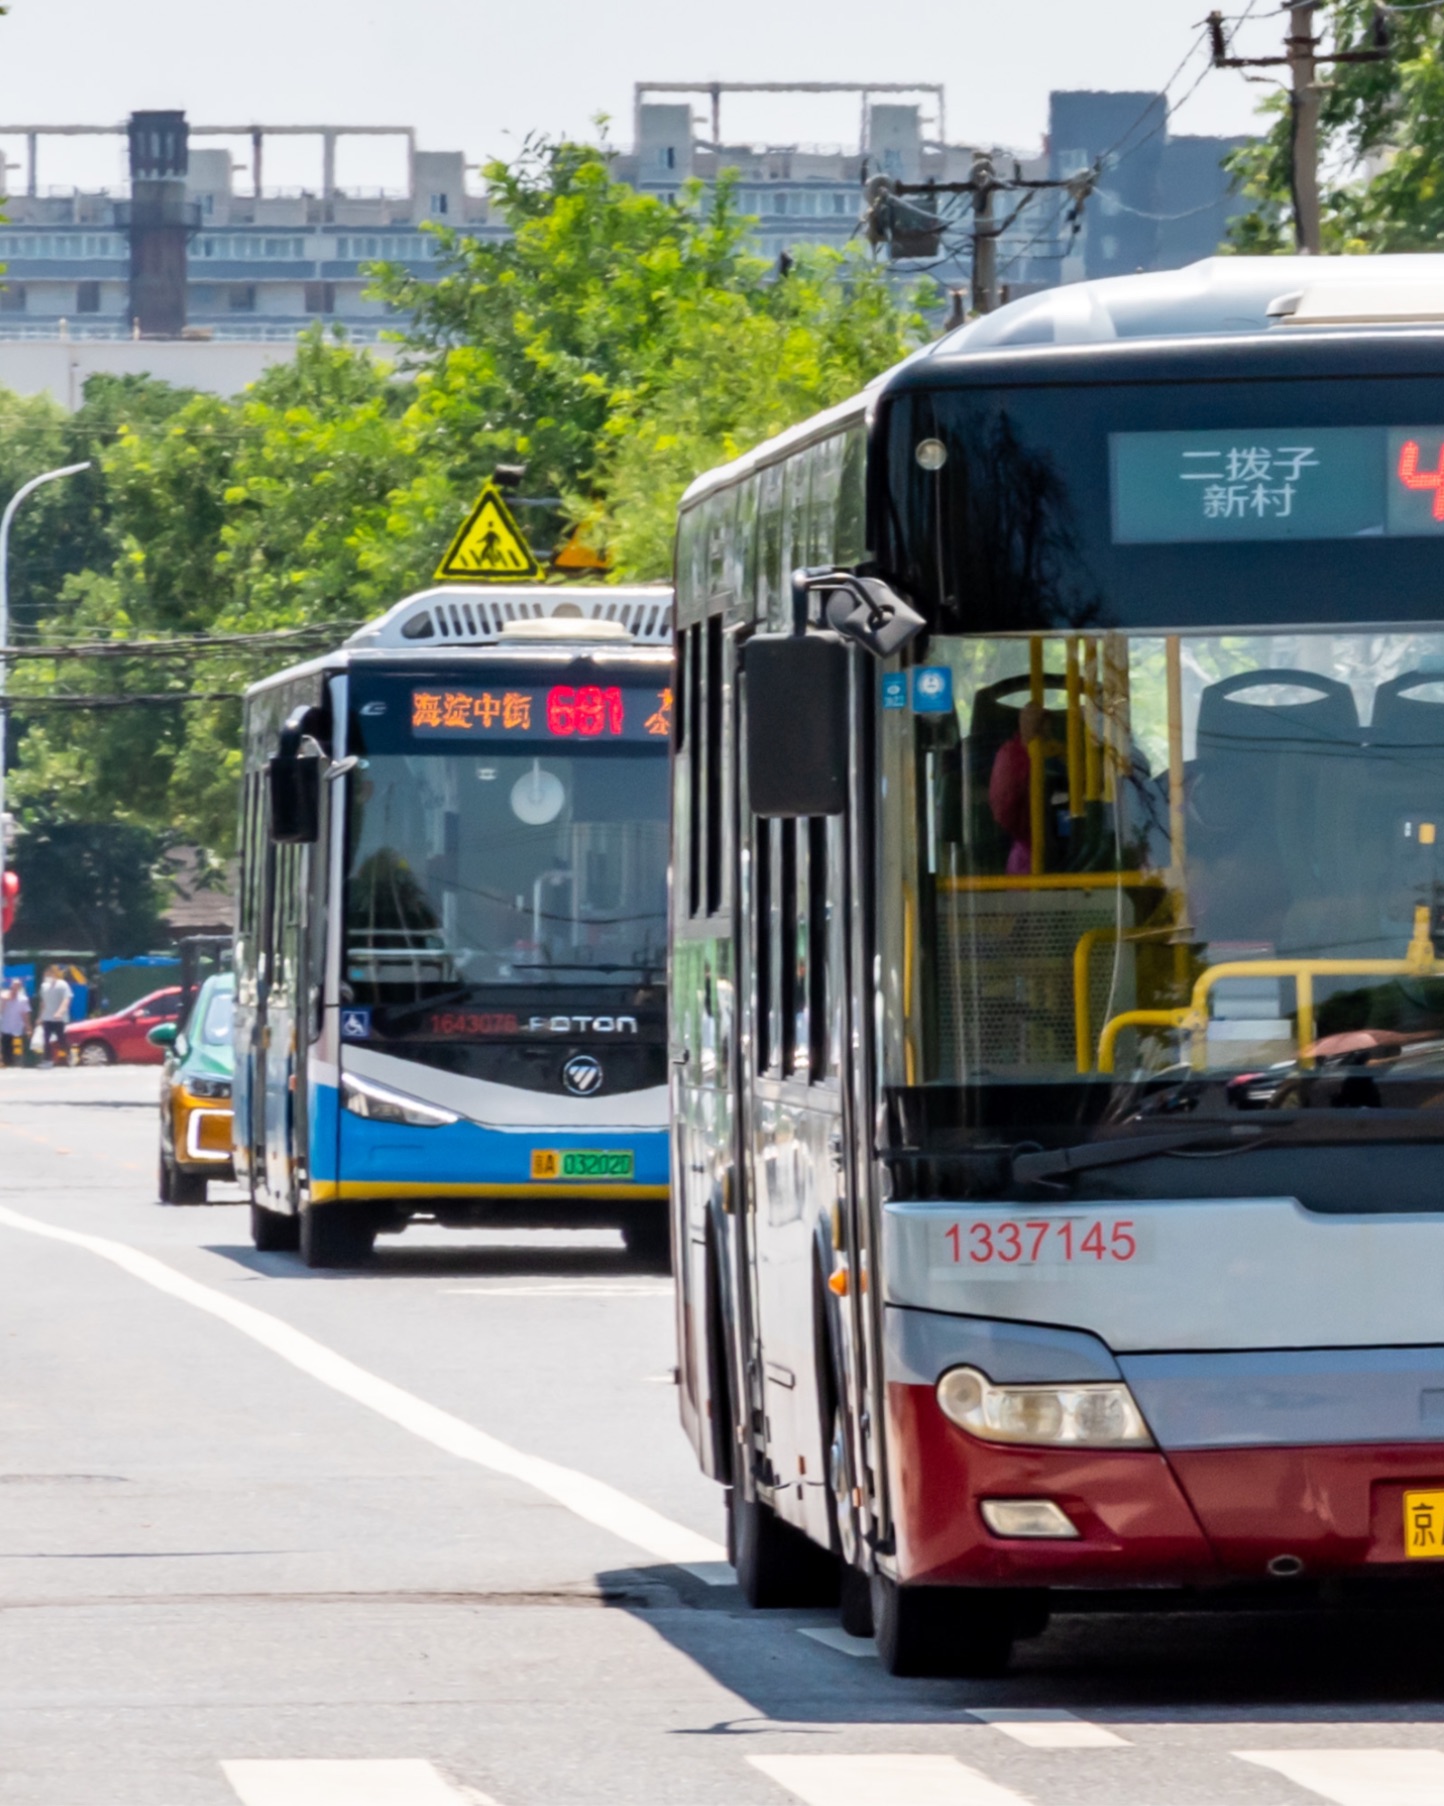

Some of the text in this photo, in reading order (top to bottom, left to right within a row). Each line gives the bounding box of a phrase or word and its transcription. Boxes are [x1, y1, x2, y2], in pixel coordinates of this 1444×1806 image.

[1179, 447, 1320, 482] 二拨子
[1203, 483, 1297, 518] 新村
[547, 685, 625, 736] 681
[945, 1221, 1136, 1263] 1337145
